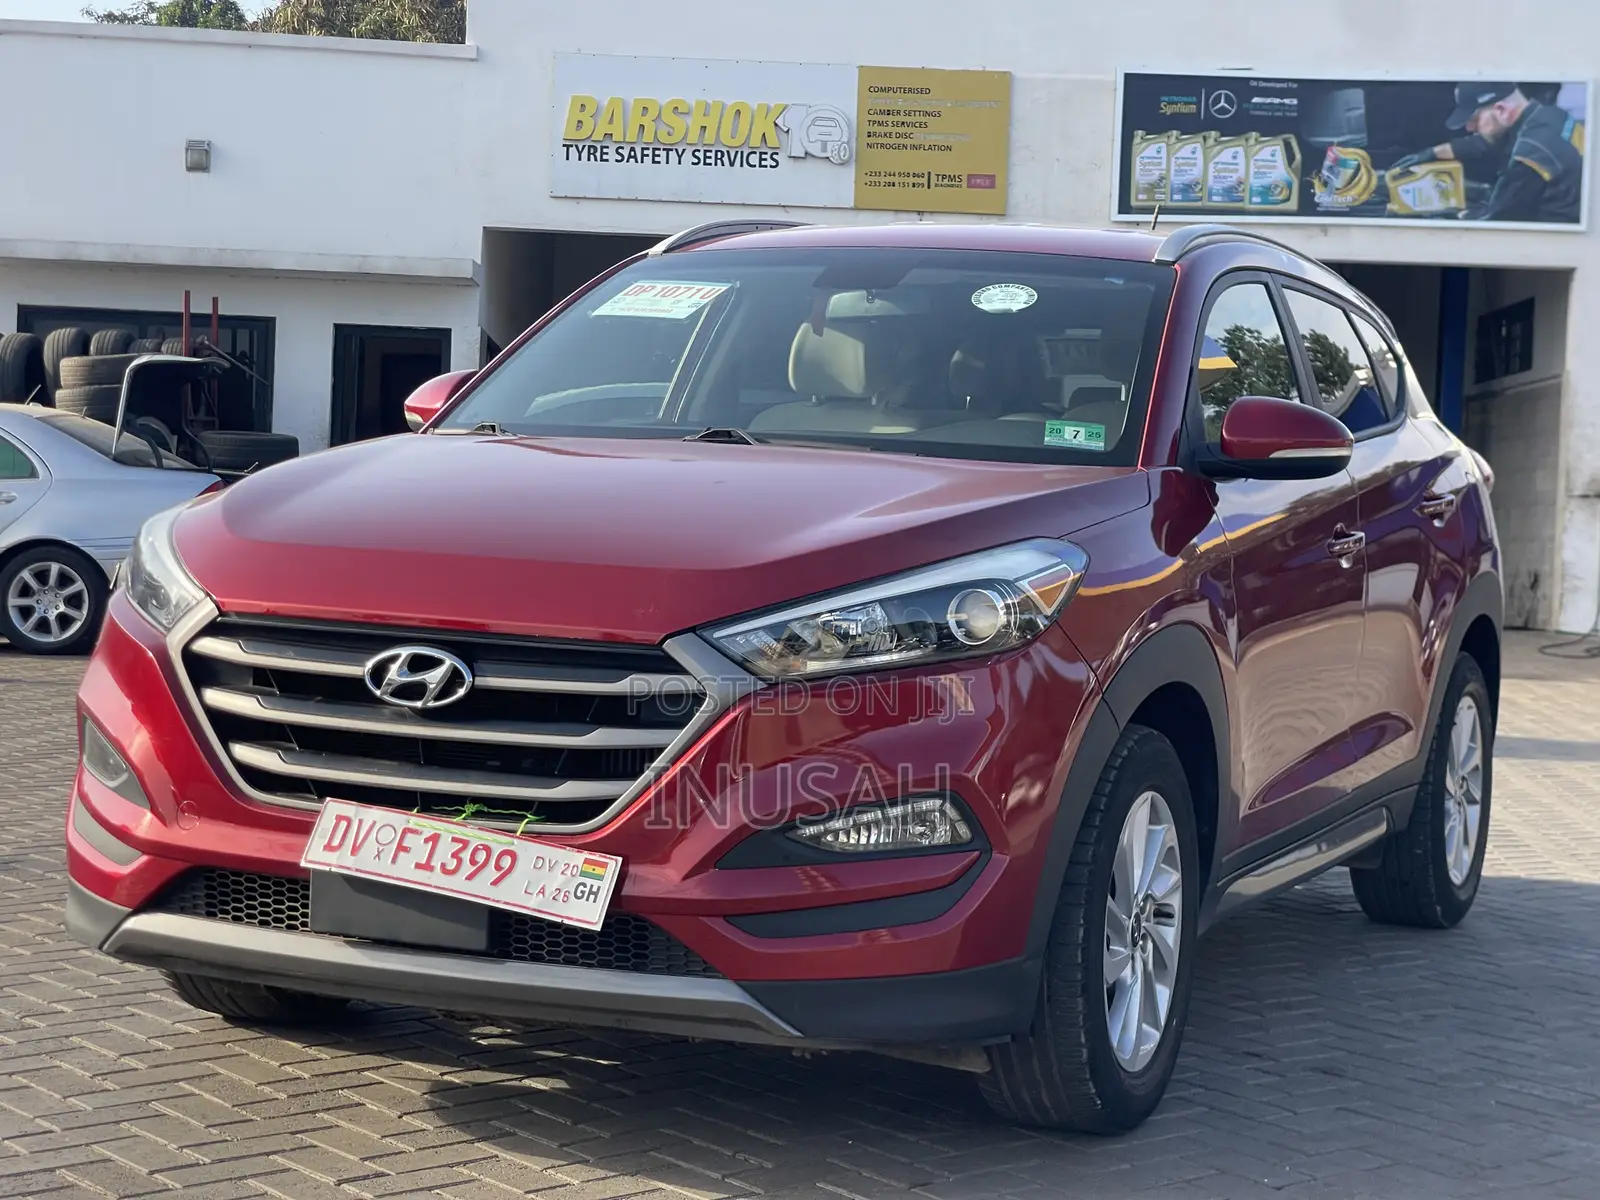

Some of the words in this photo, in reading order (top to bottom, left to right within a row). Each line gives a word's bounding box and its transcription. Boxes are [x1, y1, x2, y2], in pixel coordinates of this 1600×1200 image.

[868, 86, 931, 95] COMPUTERISED
[868, 108, 902, 117] CAMBER
[903, 110, 942, 118] SETTINGS
[563, 94, 786, 148] BARSHOK
[868, 120, 890, 128] TPMS
[891, 120, 928, 129] SERVICES
[866, 131, 893, 139] BRAKE
[894, 132, 914, 140] DISC
[866, 142, 908, 152] NITROGEN
[910, 144, 952, 152] INFLATION
[562, 144, 610, 162] TYRE
[614, 146, 686, 166] SAFETY
[691, 148, 780, 169] SERVICES
[934, 174, 963, 183] TPMS
[1072, 430, 1080, 440] 7
[322, 814, 376, 857] DV
[390, 826, 518, 886] F1399
[531, 856, 558, 872] DV
[560, 862, 579, 878] 20
[524, 880, 546, 898] LA
[550, 888, 570, 904] 26
[574, 882, 602, 904] GH
